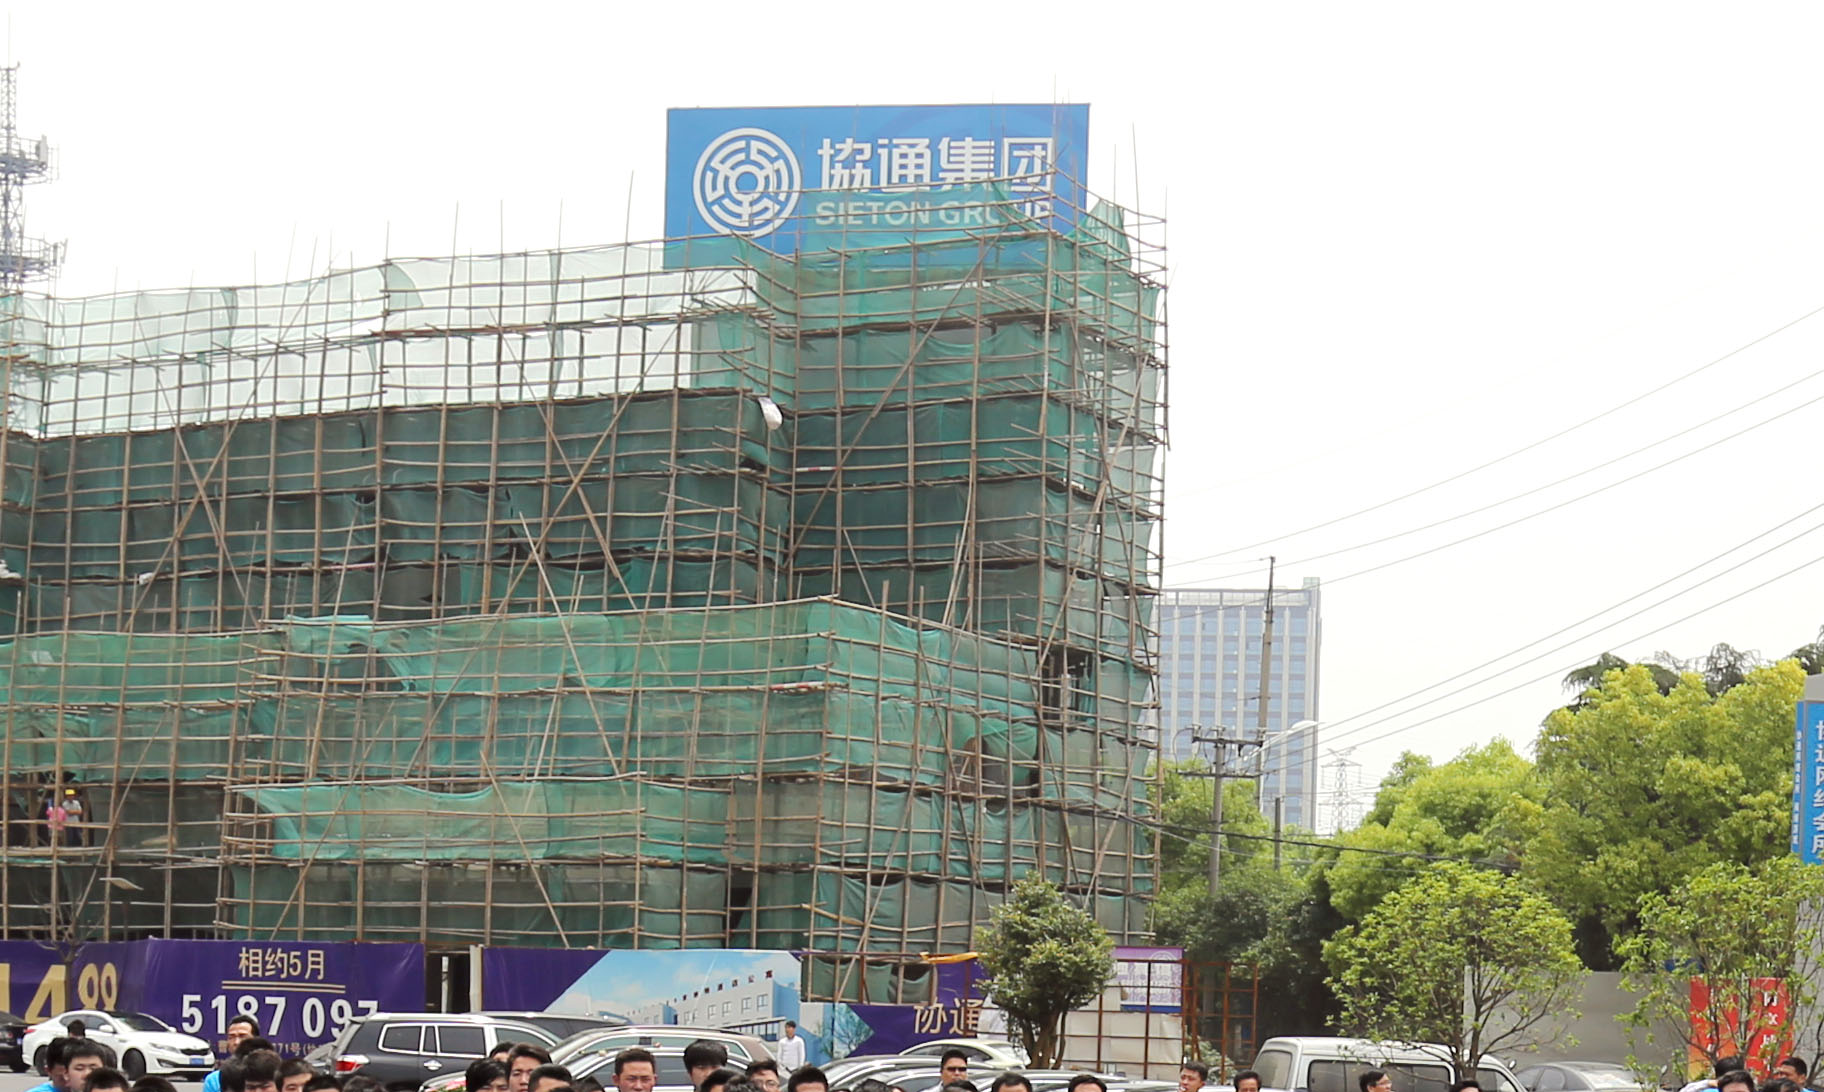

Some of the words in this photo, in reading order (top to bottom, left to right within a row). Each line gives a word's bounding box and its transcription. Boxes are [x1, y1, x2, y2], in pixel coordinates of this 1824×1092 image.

[816, 201, 930, 226] SIETON
[238, 946, 326, 981] 相约5月
